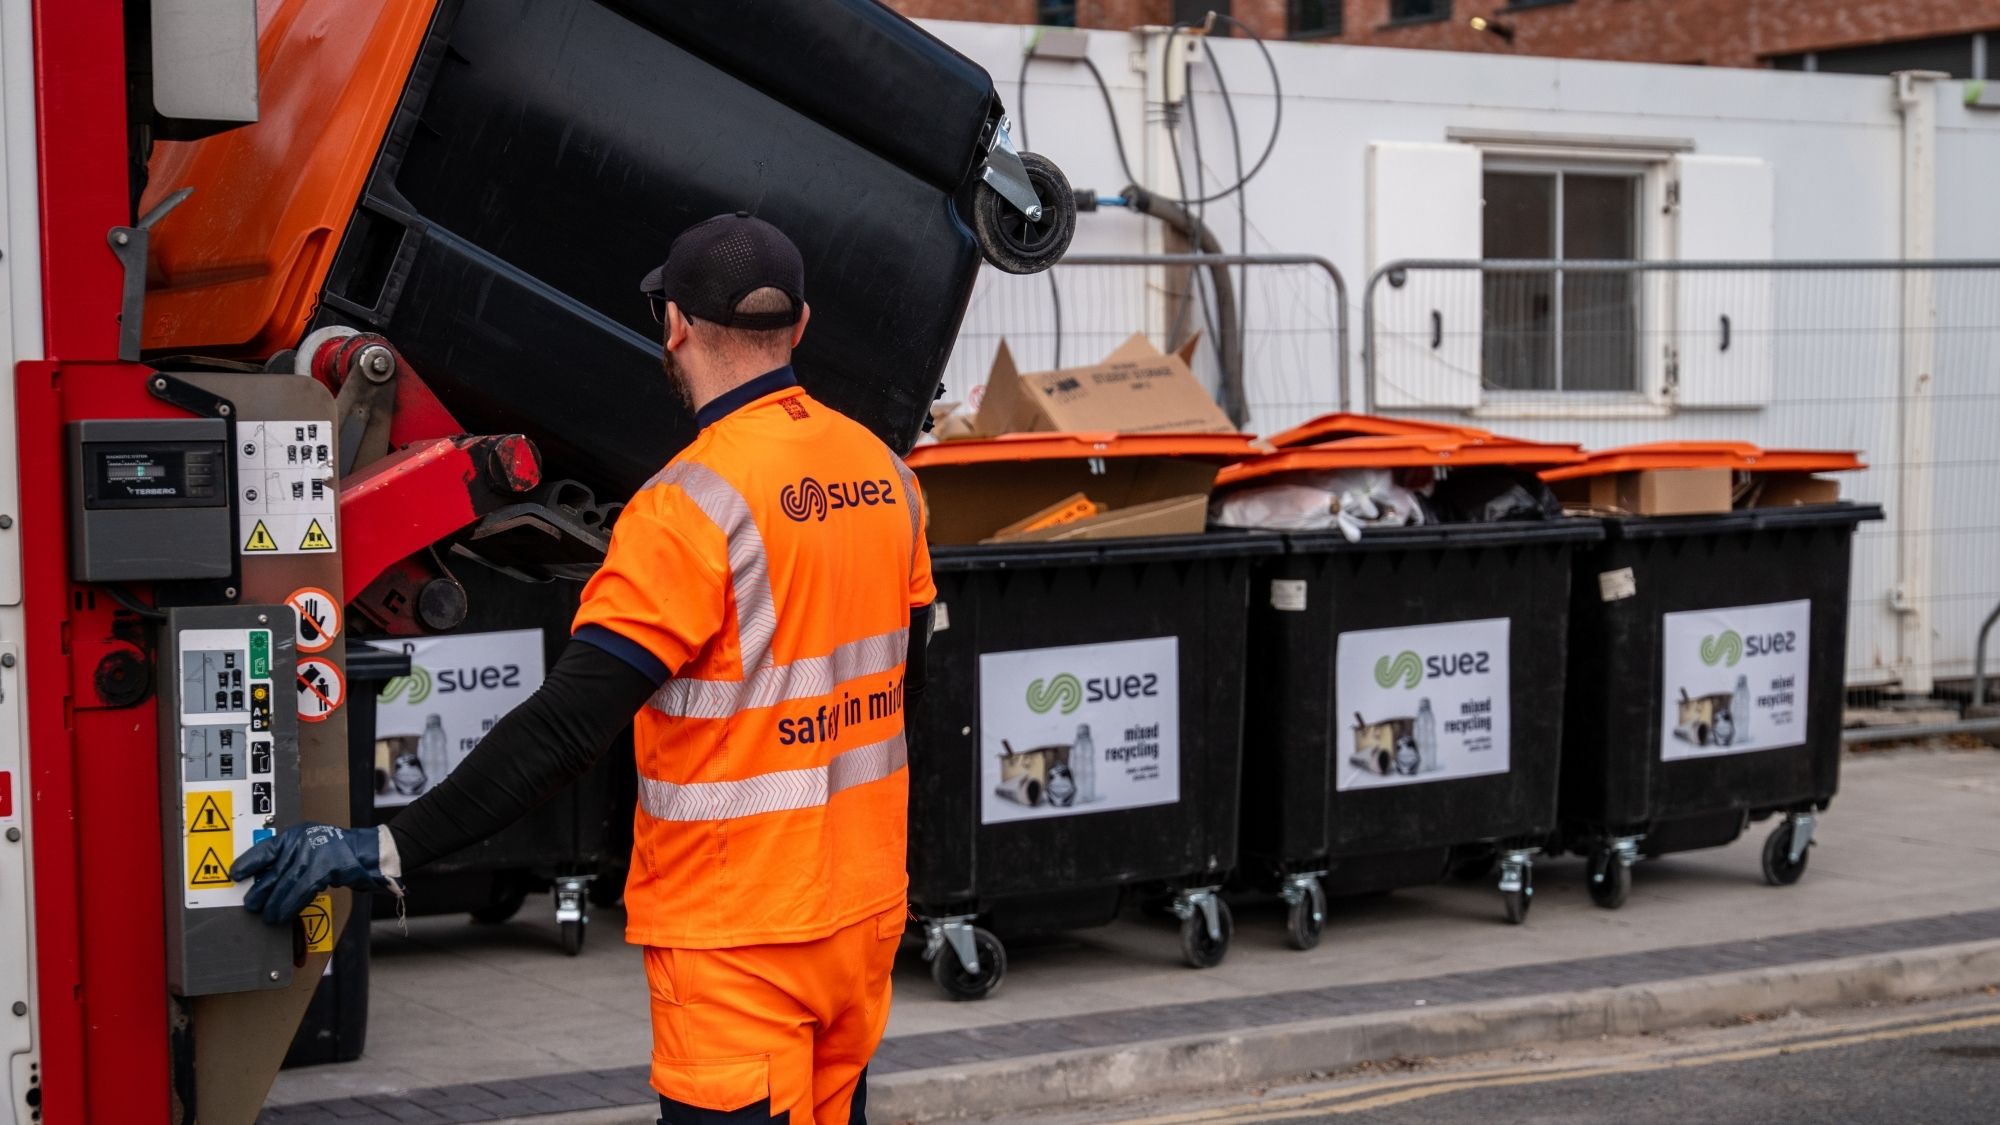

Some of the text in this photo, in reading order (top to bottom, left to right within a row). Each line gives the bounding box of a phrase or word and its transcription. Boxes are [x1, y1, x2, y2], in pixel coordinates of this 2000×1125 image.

[828, 480, 896, 509] suez
[1746, 631, 1796, 657] suez
[1426, 651, 1490, 679] suez
[437, 664, 520, 693] suez
[1087, 672, 1158, 703] suez
[253, 707, 261, 717] A
[1461, 697, 1491, 714] mixed
[253, 719, 261, 729] B
[778, 704, 840, 745] safy
[844, 692, 861, 727] in
[1445, 715, 1491, 733] recycling
[1124, 722, 1159, 742] mixed
[1105, 742, 1159, 763] recycling
